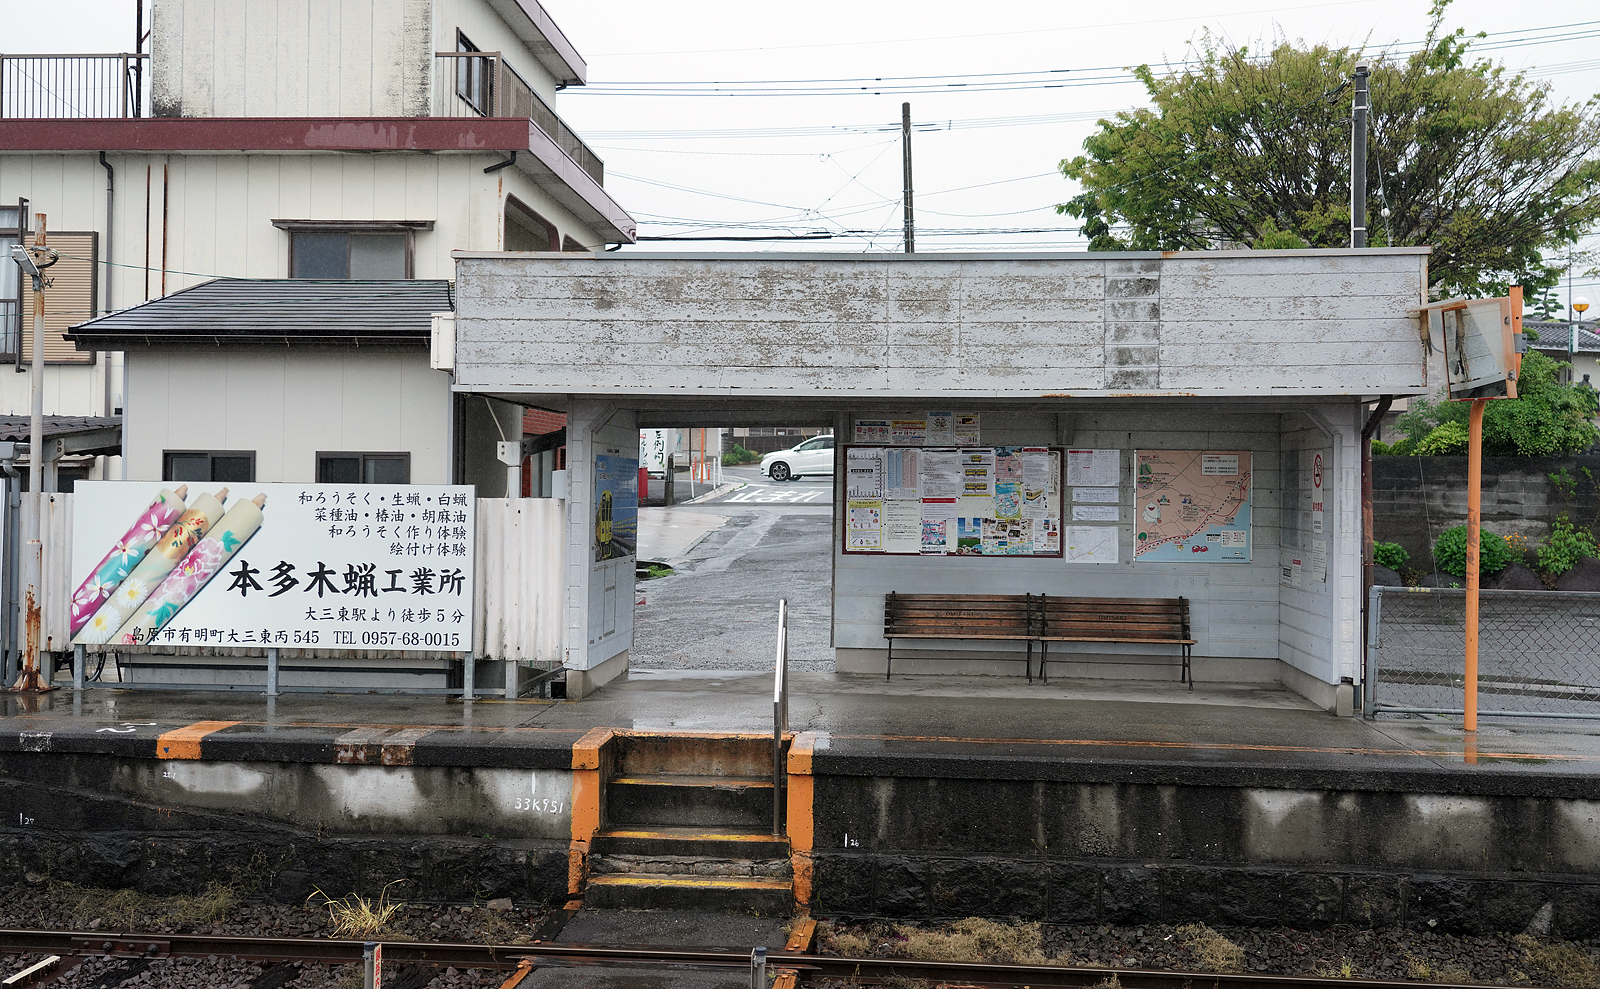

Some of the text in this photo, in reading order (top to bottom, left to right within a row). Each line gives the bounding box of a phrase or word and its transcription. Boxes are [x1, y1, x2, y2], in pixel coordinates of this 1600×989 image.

[298, 491, 468, 506] 和ろうそく・生蝋・白蝋
[723, 489, 825, 502] 止まれ
[315, 507, 467, 523] 菜種油・椿油・胡麻油
[328, 525, 467, 540] 和ろうそく作り体験
[389, 542, 467, 557] 絵付け体験
[227, 560, 465, 598] 本多木蝋工業所
[132, 626, 289, 644] 島原市有明町大三東丙
[293, 630, 320, 644] 545
[333, 630, 357, 645] TEL
[361, 631, 460, 646] 0957-68-0015
